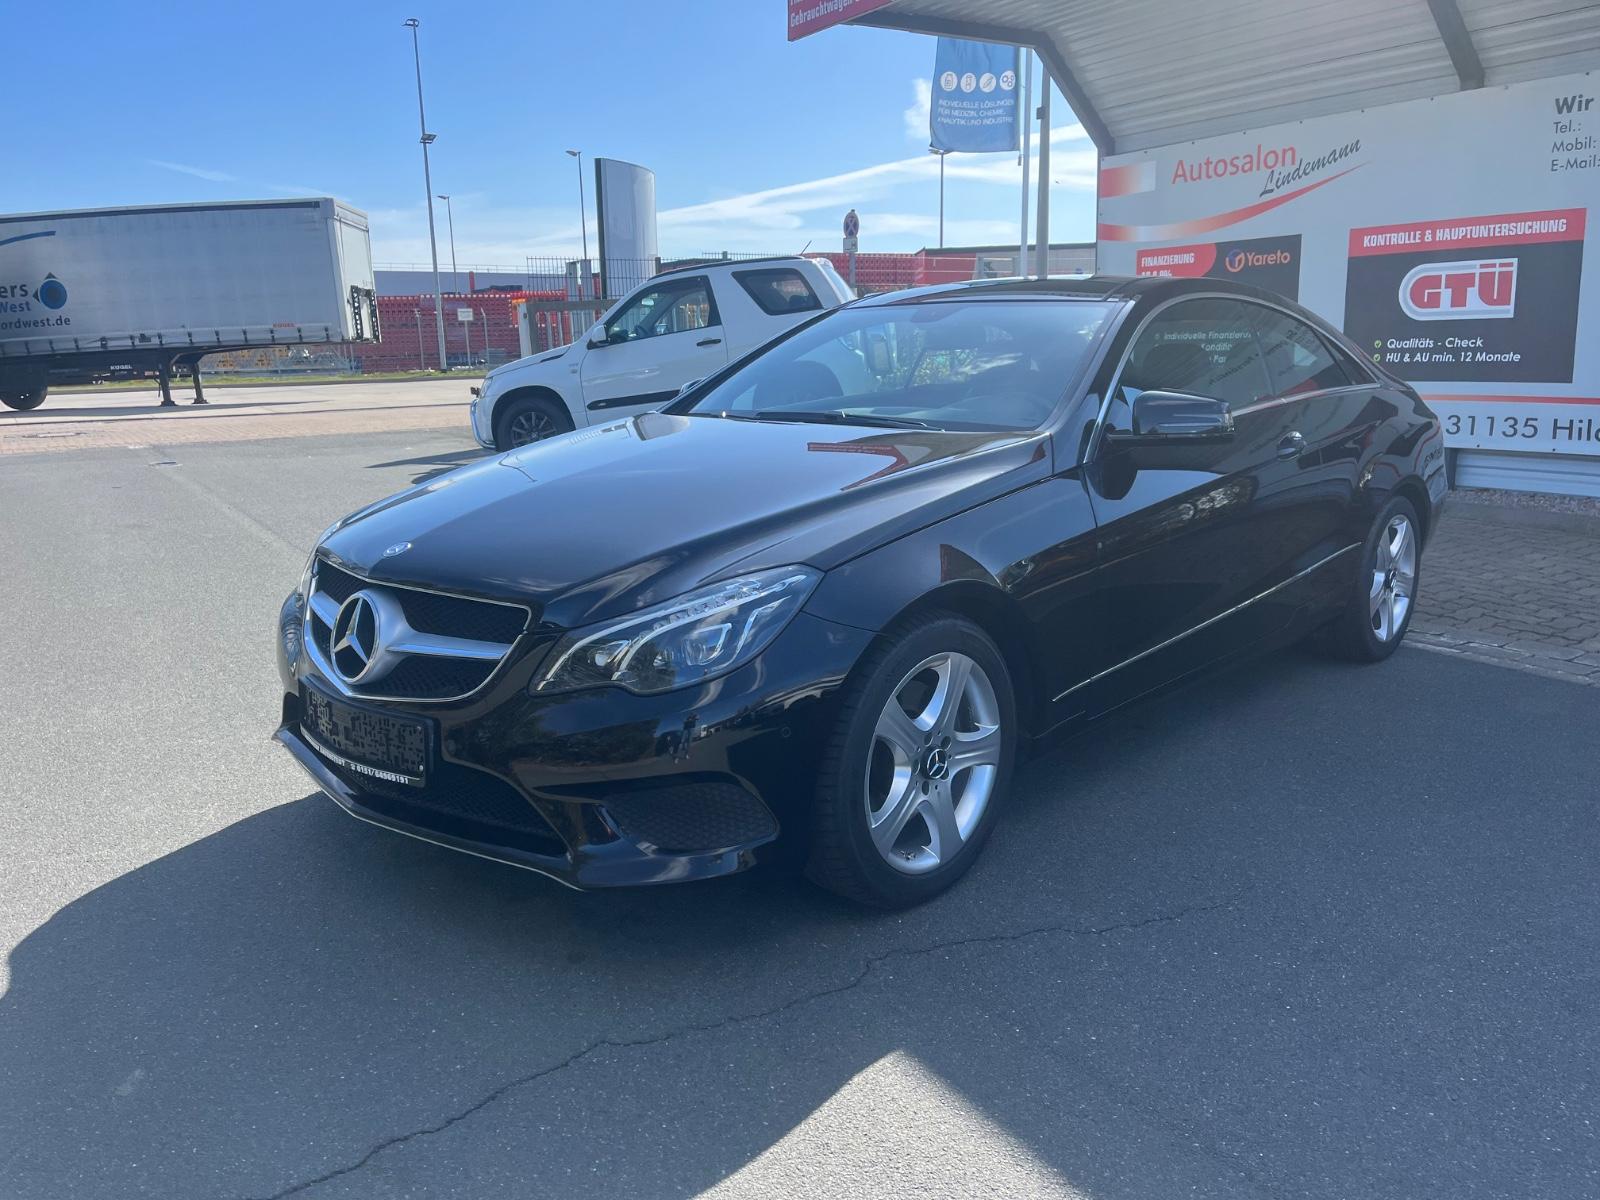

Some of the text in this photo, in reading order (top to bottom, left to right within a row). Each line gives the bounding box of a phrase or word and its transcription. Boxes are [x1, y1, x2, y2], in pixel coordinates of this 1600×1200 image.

[1555, 94, 1594, 115] Wir
[1553, 119, 1582, 135] Tel.:
[1551, 136, 1597, 153] Mobil:
[1171, 144, 1297, 184] Autosalon
[1259, 138, 1361, 198] Lindemann
[1363, 219, 1567, 247] KONTROLLE & HAUPTUNTERSUCHUNG
[1141, 252, 1195, 268] FINANZIERUNG
[1246, 249, 1291, 266] Yareto
[1409, 261, 1514, 309] GTÜ
[1387, 338, 1434, 350] Qualitäts
[1445, 337, 1484, 349] Check
[1385, 351, 1521, 363] HU & AU min. 12 Monate
[1445, 414, 1539, 440] 31135
